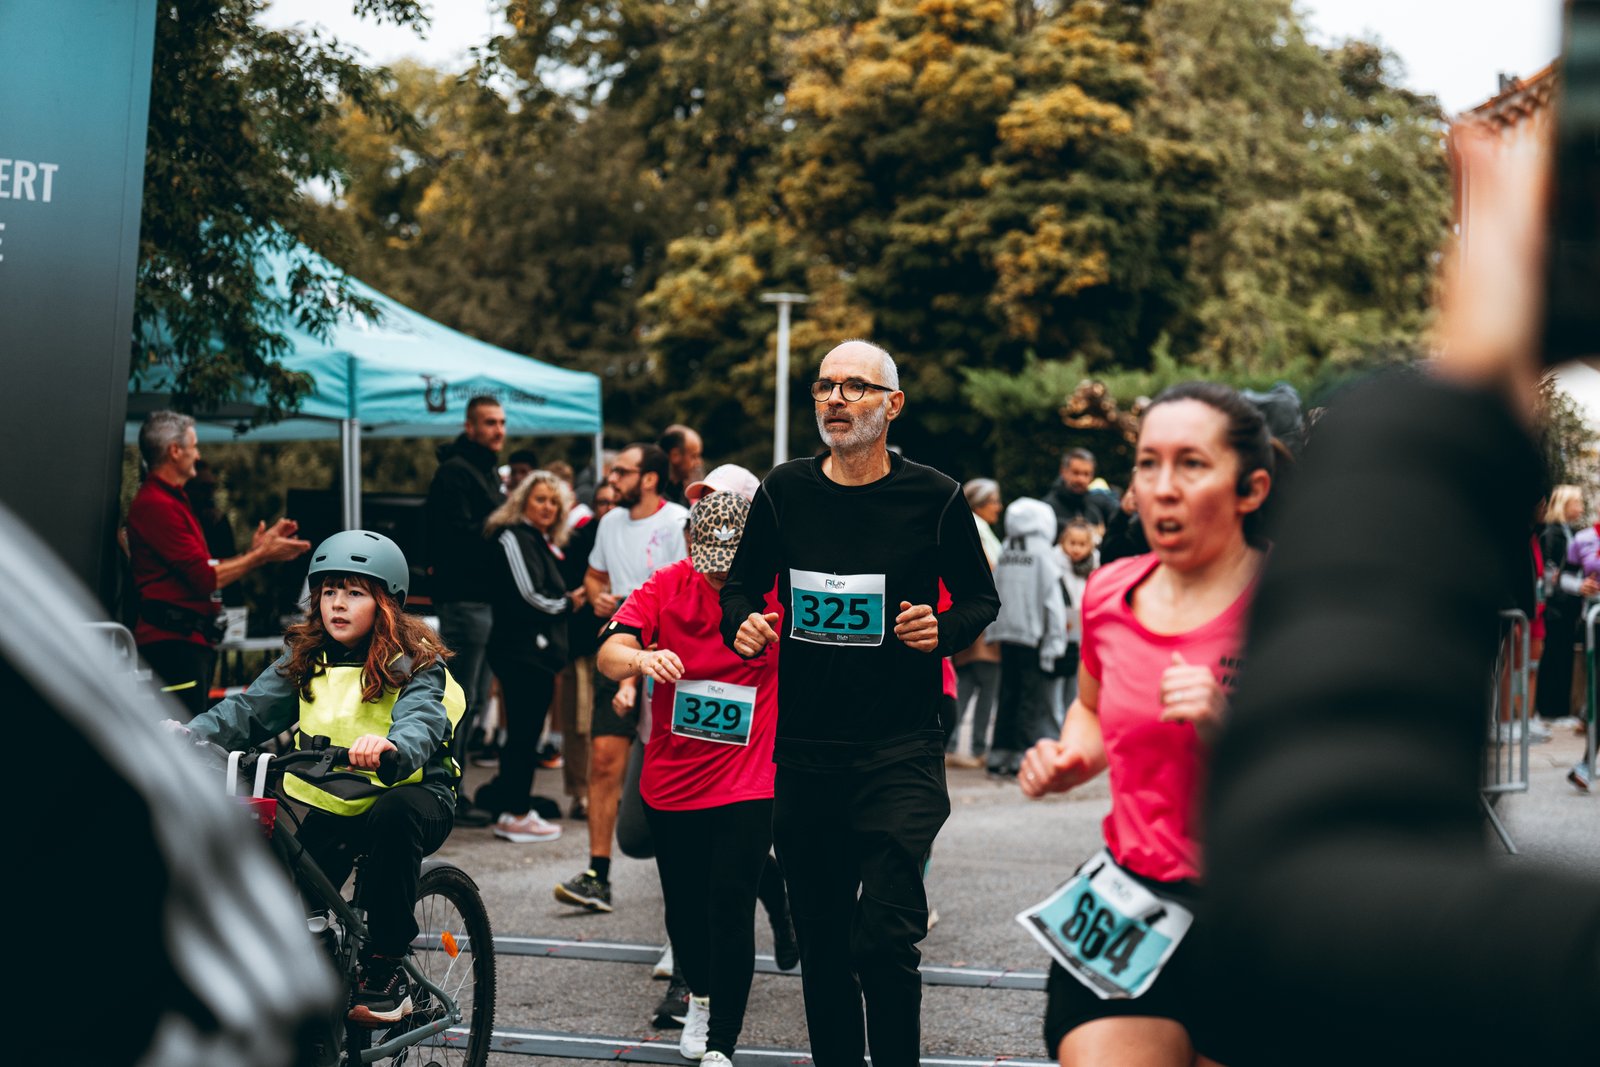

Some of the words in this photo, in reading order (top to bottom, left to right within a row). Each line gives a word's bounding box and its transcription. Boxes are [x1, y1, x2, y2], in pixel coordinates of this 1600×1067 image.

[801, 594, 870, 631] 325
[682, 697, 742, 731] 329
[1060, 892, 1146, 976] 664
